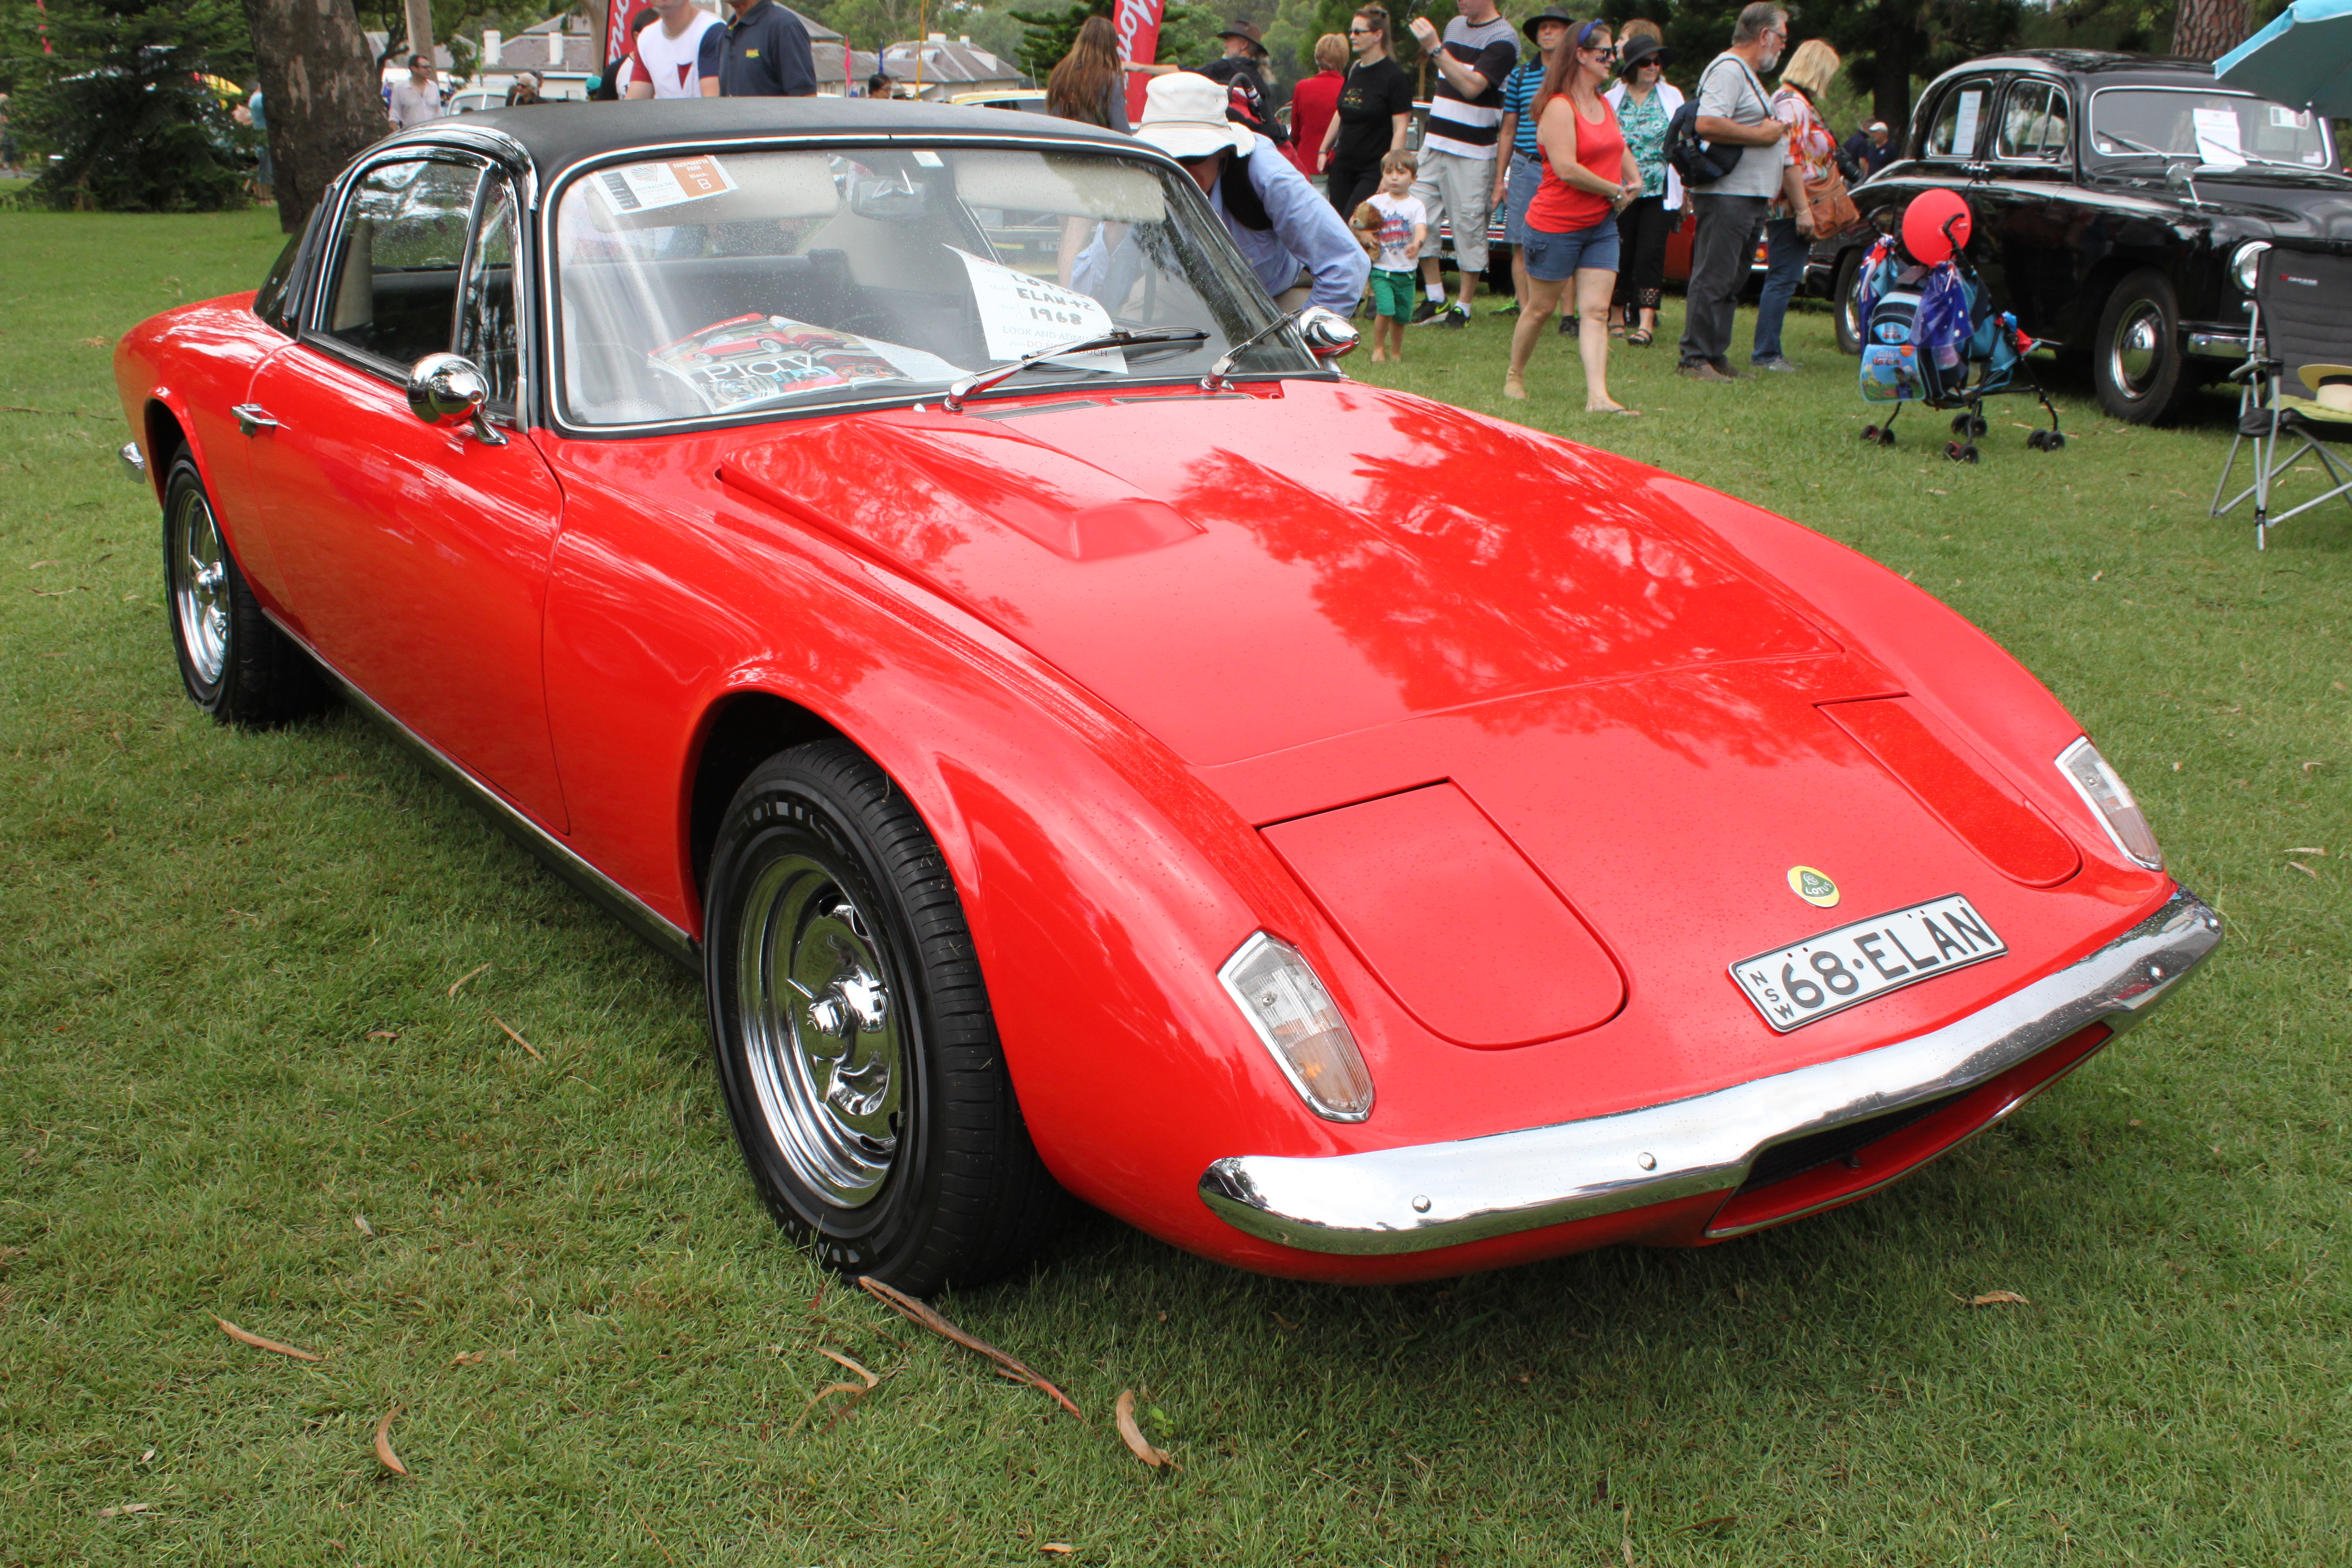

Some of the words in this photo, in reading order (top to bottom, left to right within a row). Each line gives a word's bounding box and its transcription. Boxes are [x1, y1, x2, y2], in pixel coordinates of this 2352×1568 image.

[673, 159, 709, 169] PARRAMATTA
[635, 183, 664, 192] AUSTRALIA
[697, 179, 712, 190] B
[1015, 287, 1067, 306] ELAN
[1029, 306, 1082, 326] 1968
[1002, 325, 1032, 336] LOOK
[1034, 329, 1056, 339] AND
[1078, 348, 1108, 357] OUCH
[729, 795, 839, 848] SOLUS
[1805, 882, 1832, 894] LOTUS
[1750, 971, 1794, 1020] NSW
